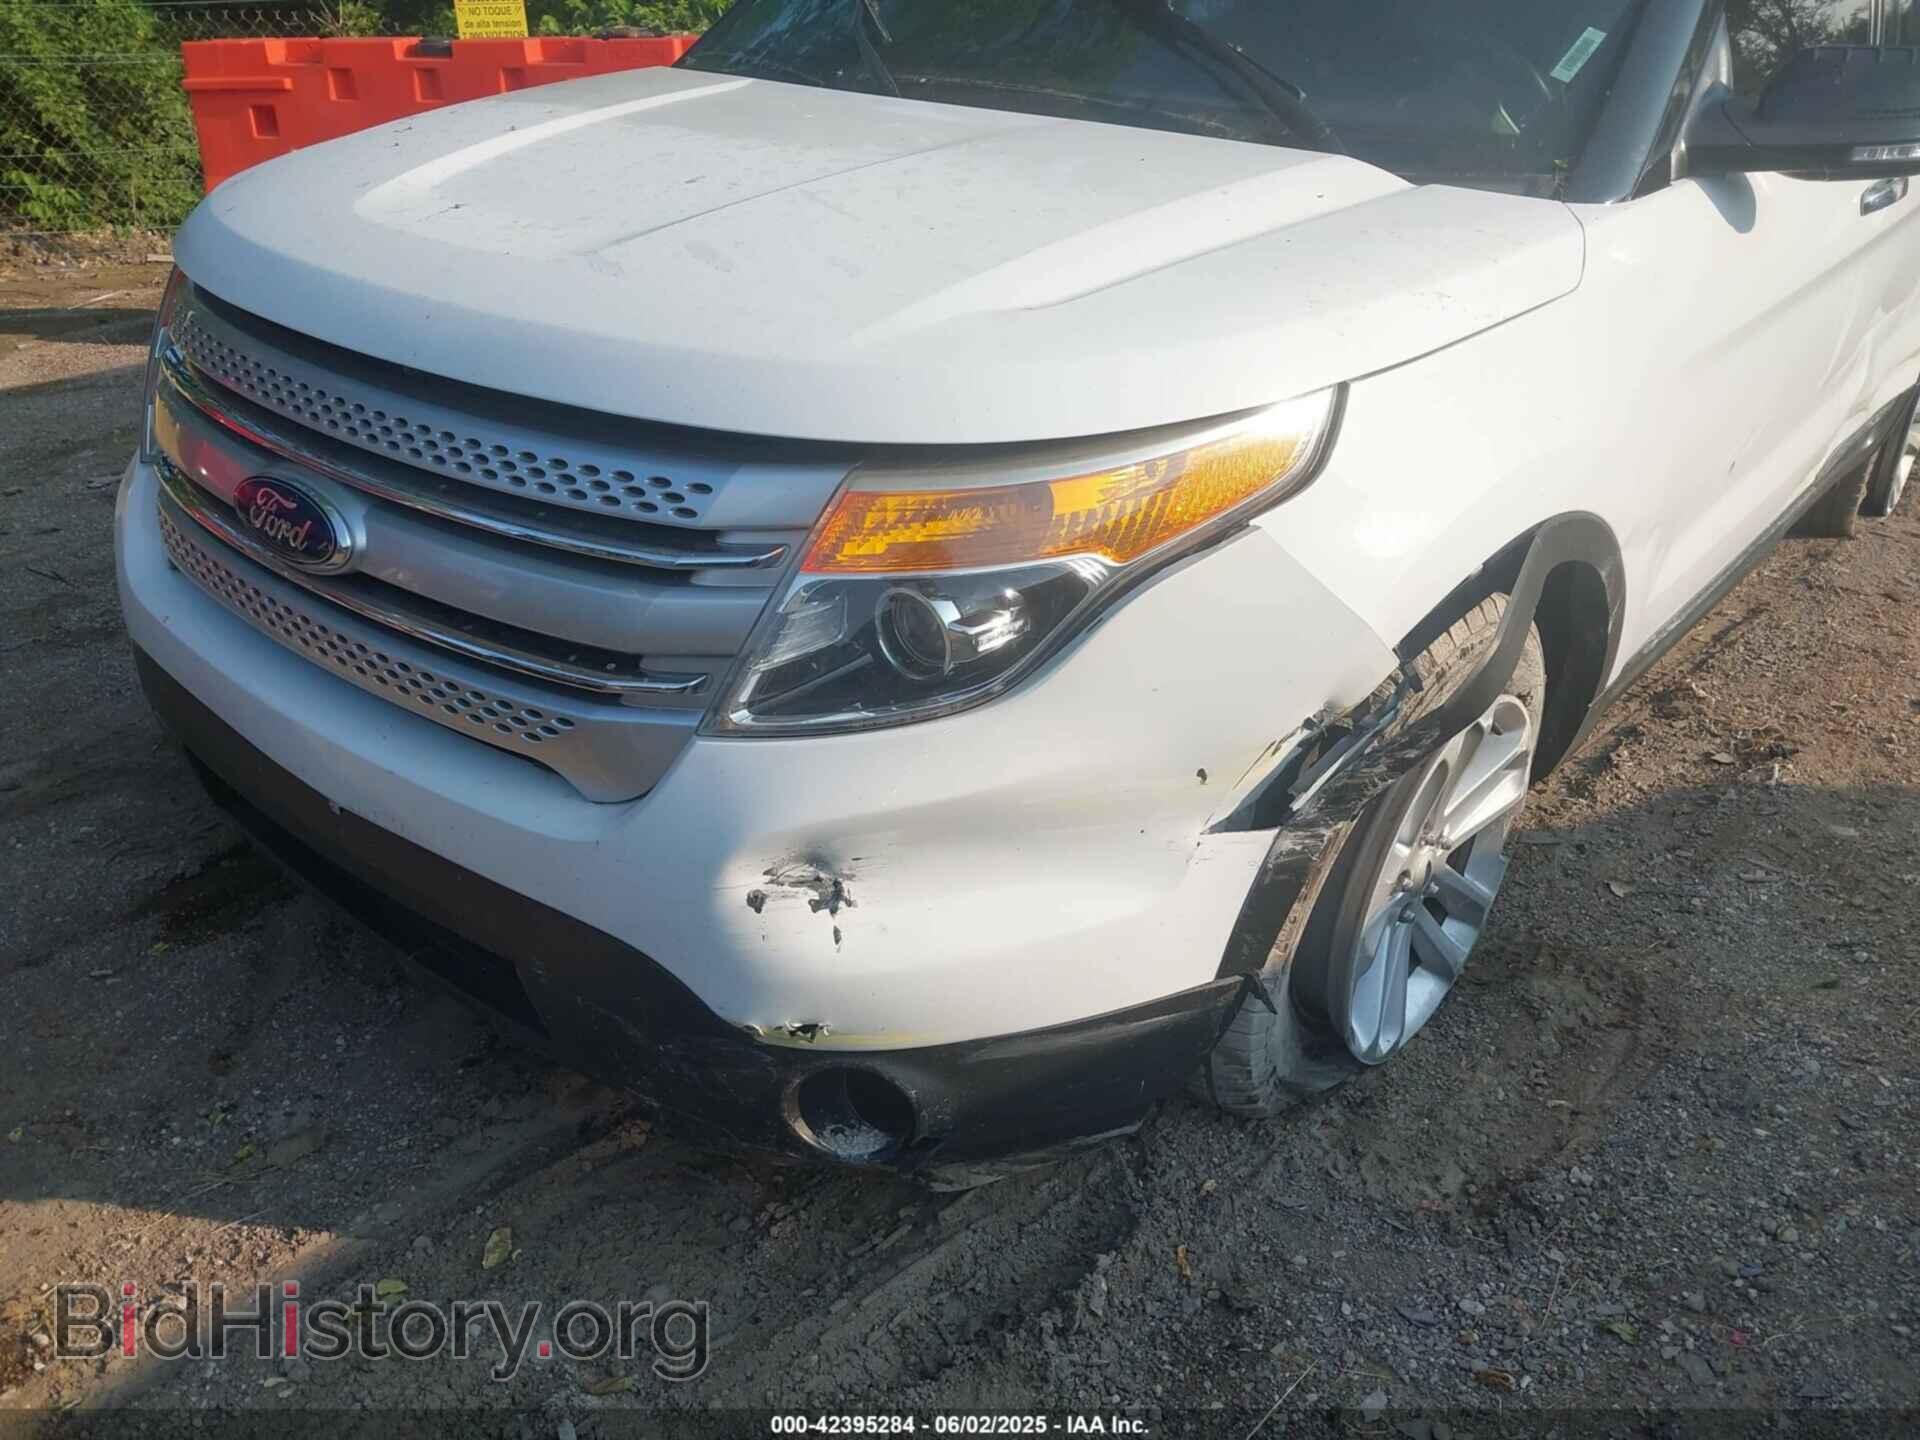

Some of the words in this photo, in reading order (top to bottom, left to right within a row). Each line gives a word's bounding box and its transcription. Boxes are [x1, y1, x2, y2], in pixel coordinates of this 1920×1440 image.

[468, 6, 481, 16] NO
[483, 6, 513, 16] TOQUE
[476, 19, 490, 28] alta
[251, 487, 313, 550] Ford
